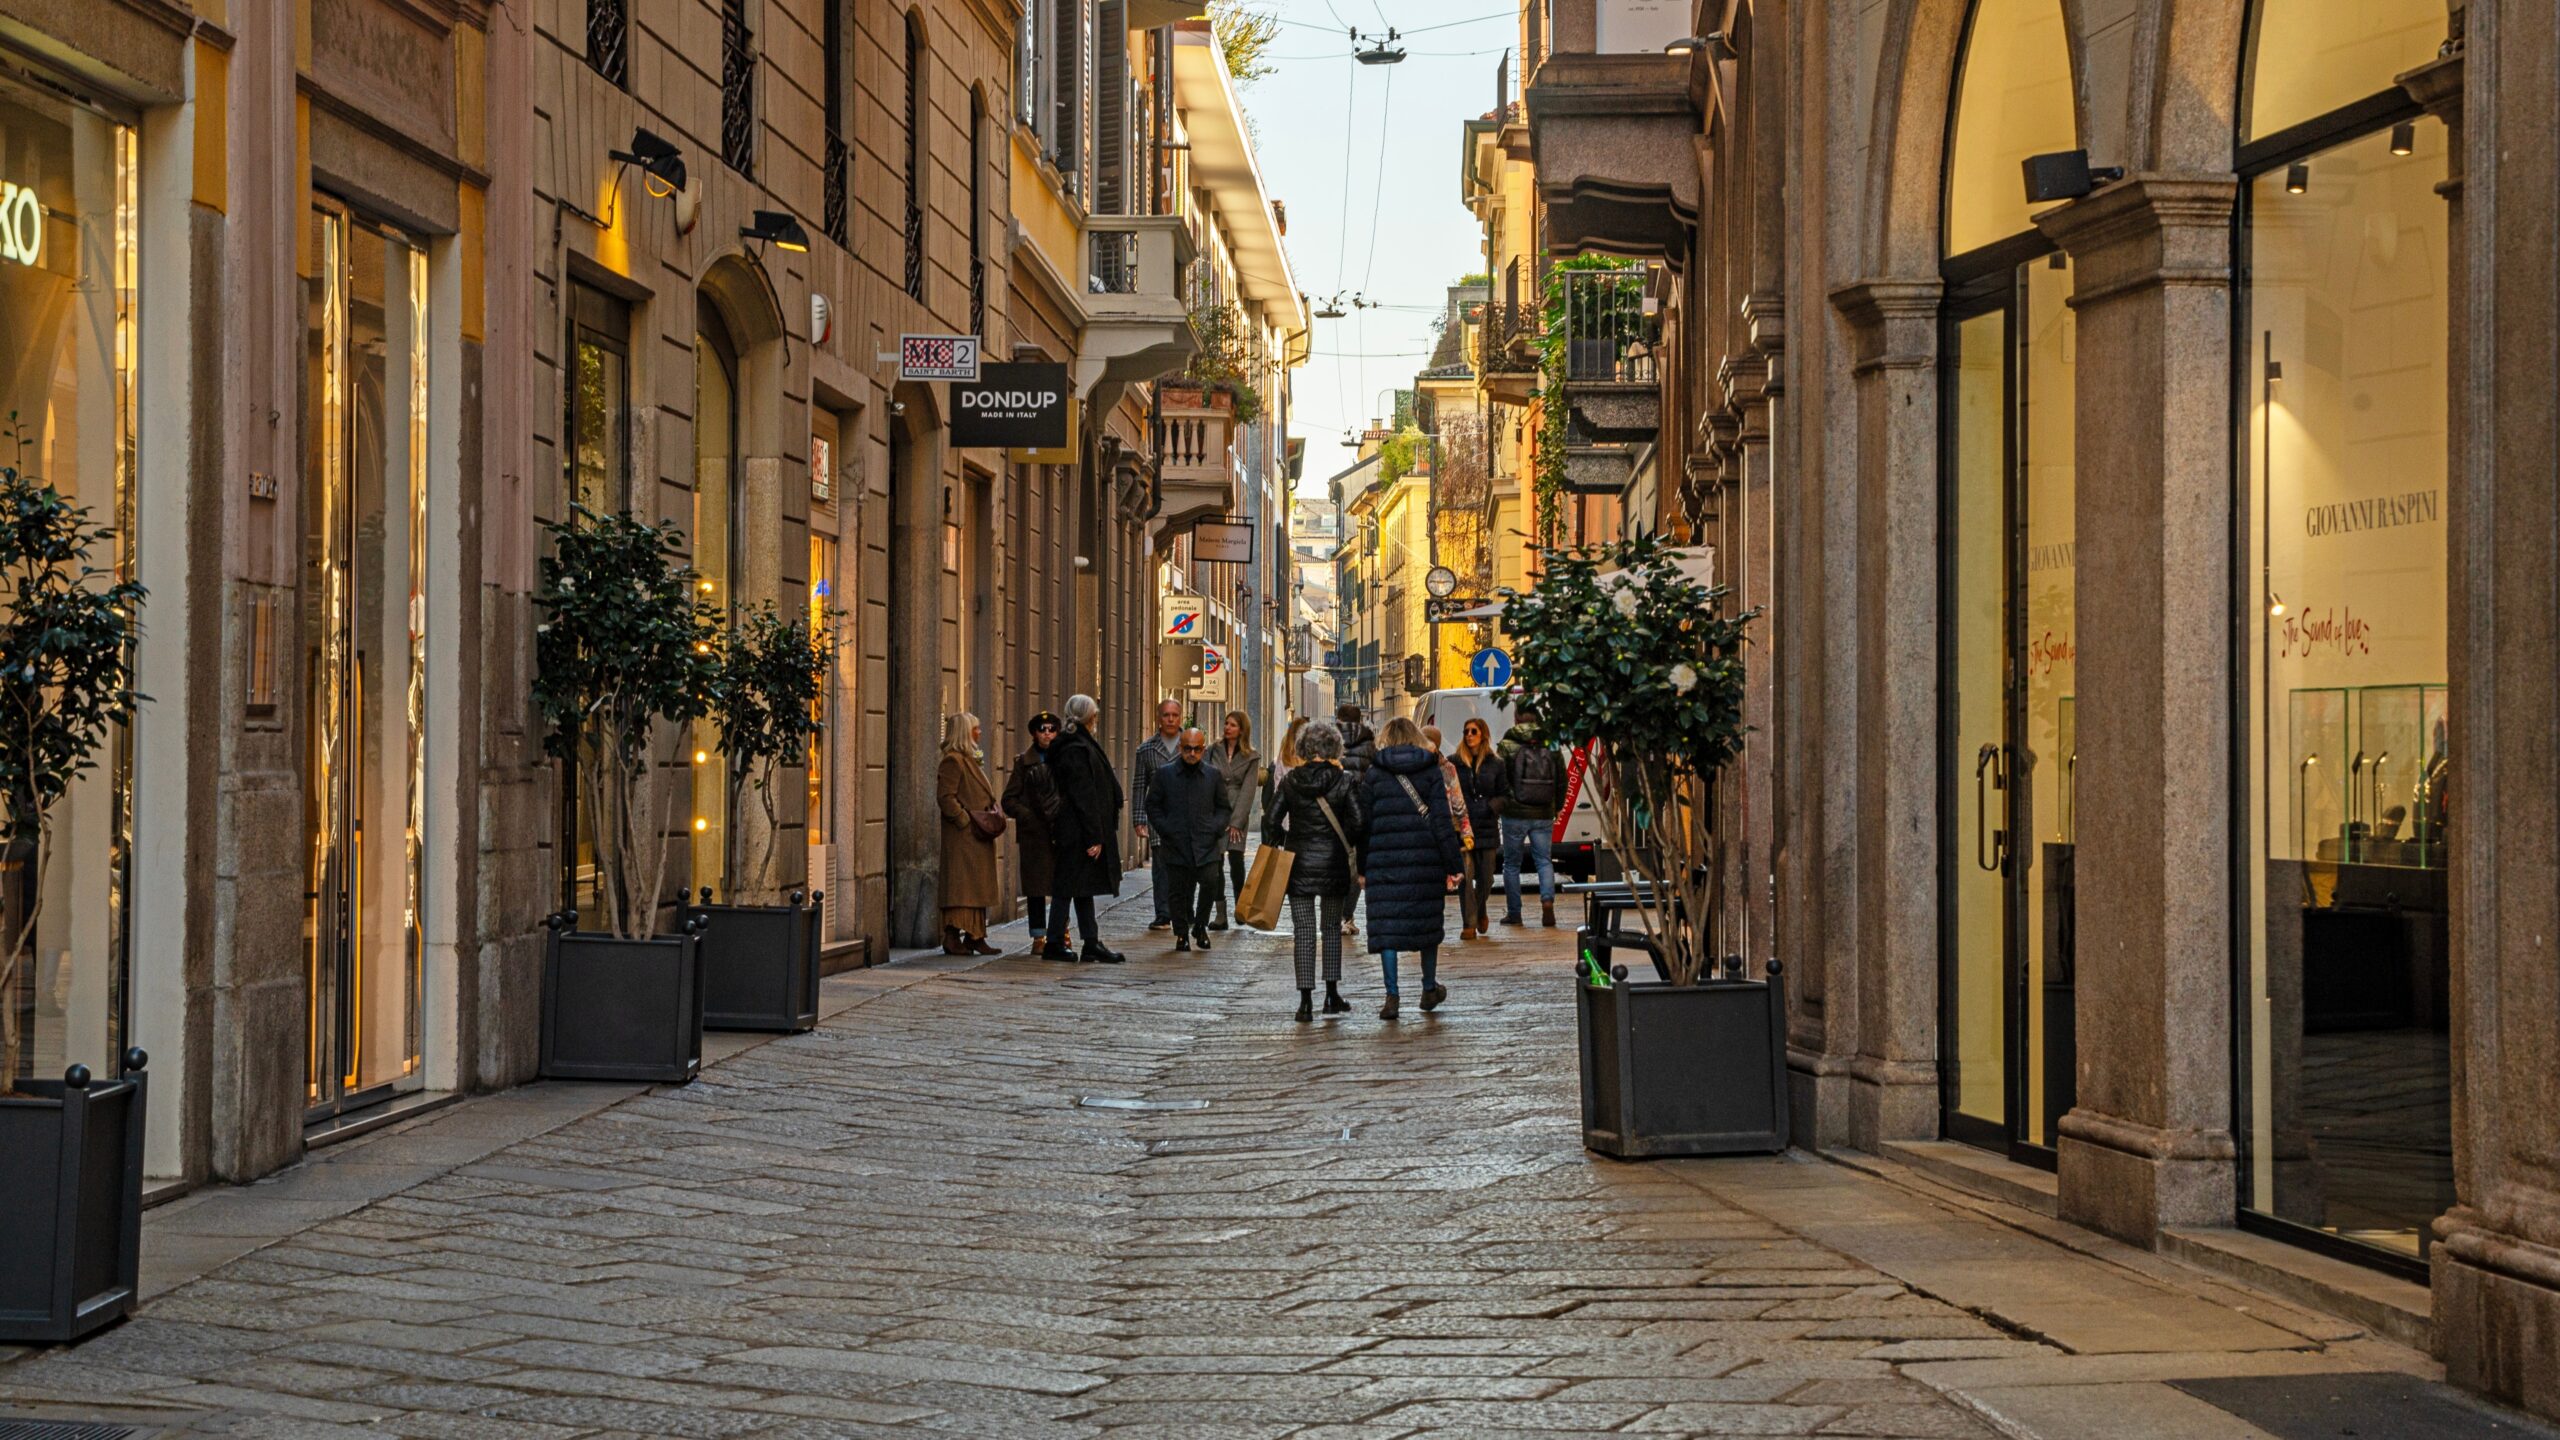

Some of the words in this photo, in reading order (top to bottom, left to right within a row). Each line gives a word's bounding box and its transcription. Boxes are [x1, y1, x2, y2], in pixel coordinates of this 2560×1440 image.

[908, 368, 935, 376] SAINT
[962, 391, 1057, 409] DONDUP
[2306, 498, 2374, 538] GIOVANNI
[2378, 489, 2437, 529] RASPINI
[2044, 631, 2069, 675] Sound
[2285, 616, 2298, 655] The
[2301, 606, 2334, 658] Sound
[2345, 606, 2361, 657] Love
